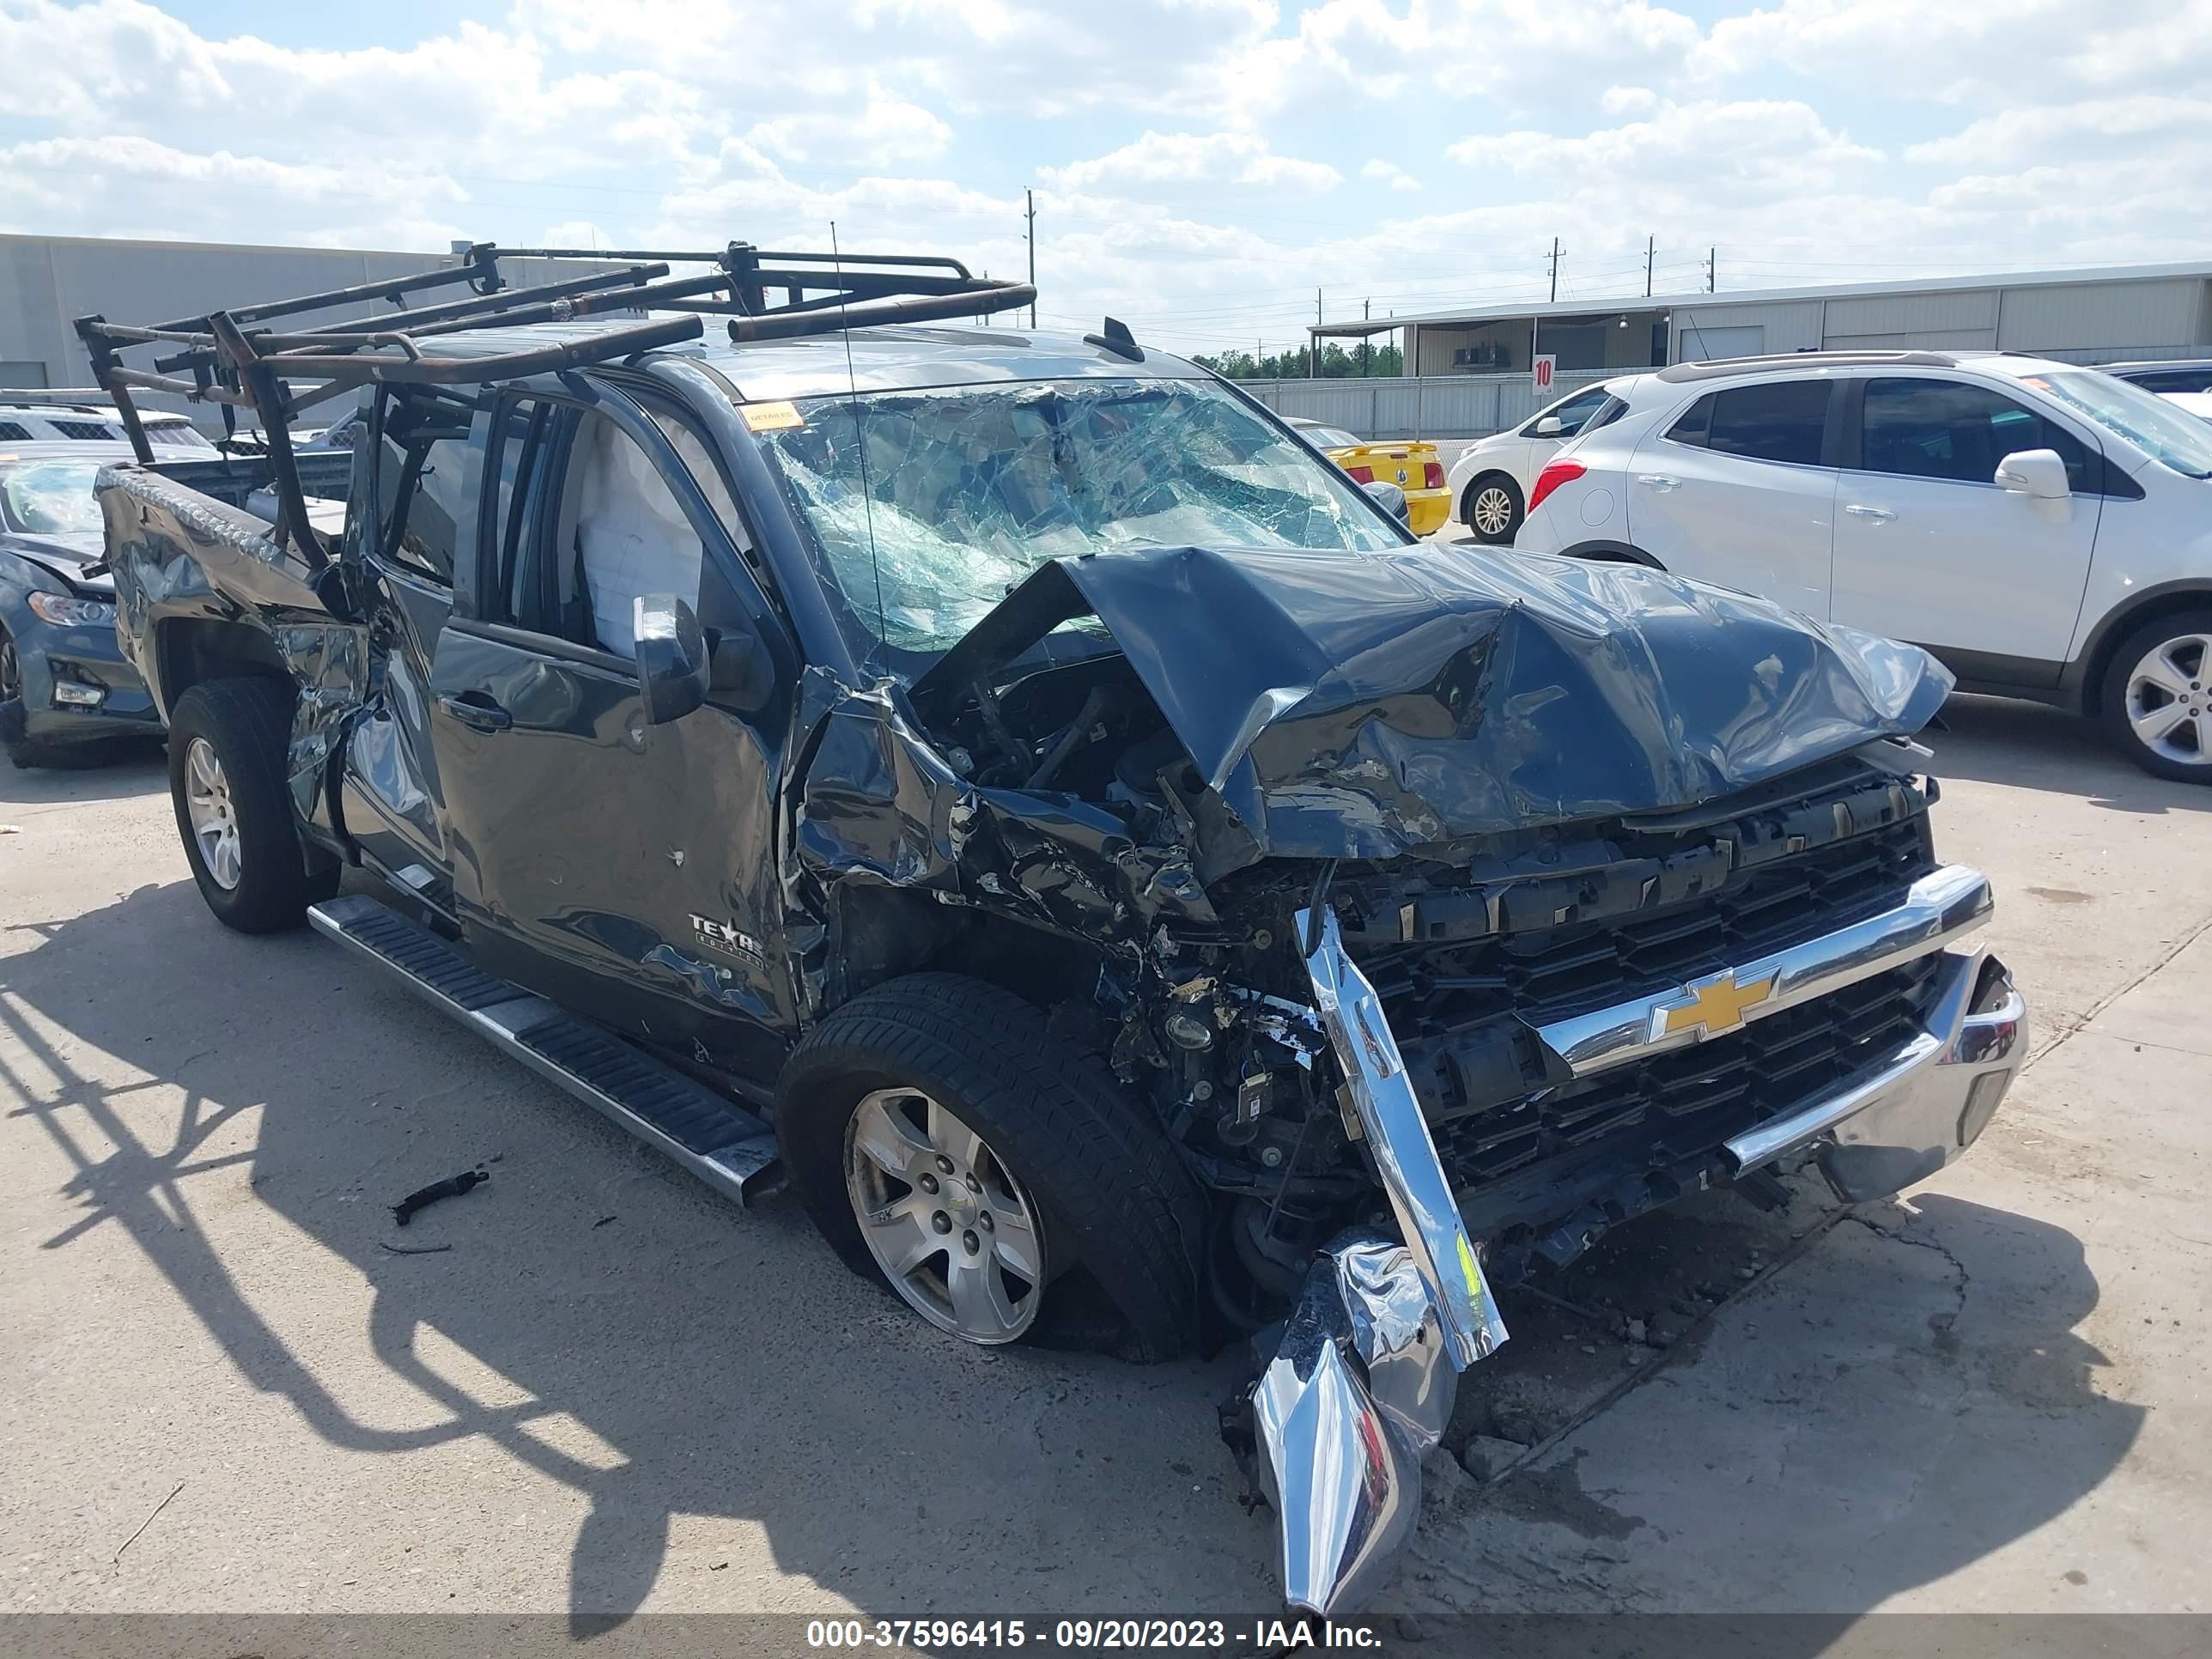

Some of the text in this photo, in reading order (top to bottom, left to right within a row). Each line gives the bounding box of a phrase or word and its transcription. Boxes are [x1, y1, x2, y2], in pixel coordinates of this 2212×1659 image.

[1536, 360, 1552, 386] 10
[750, 411, 793, 422] DETAILED
[700, 936, 761, 967] EDITION
